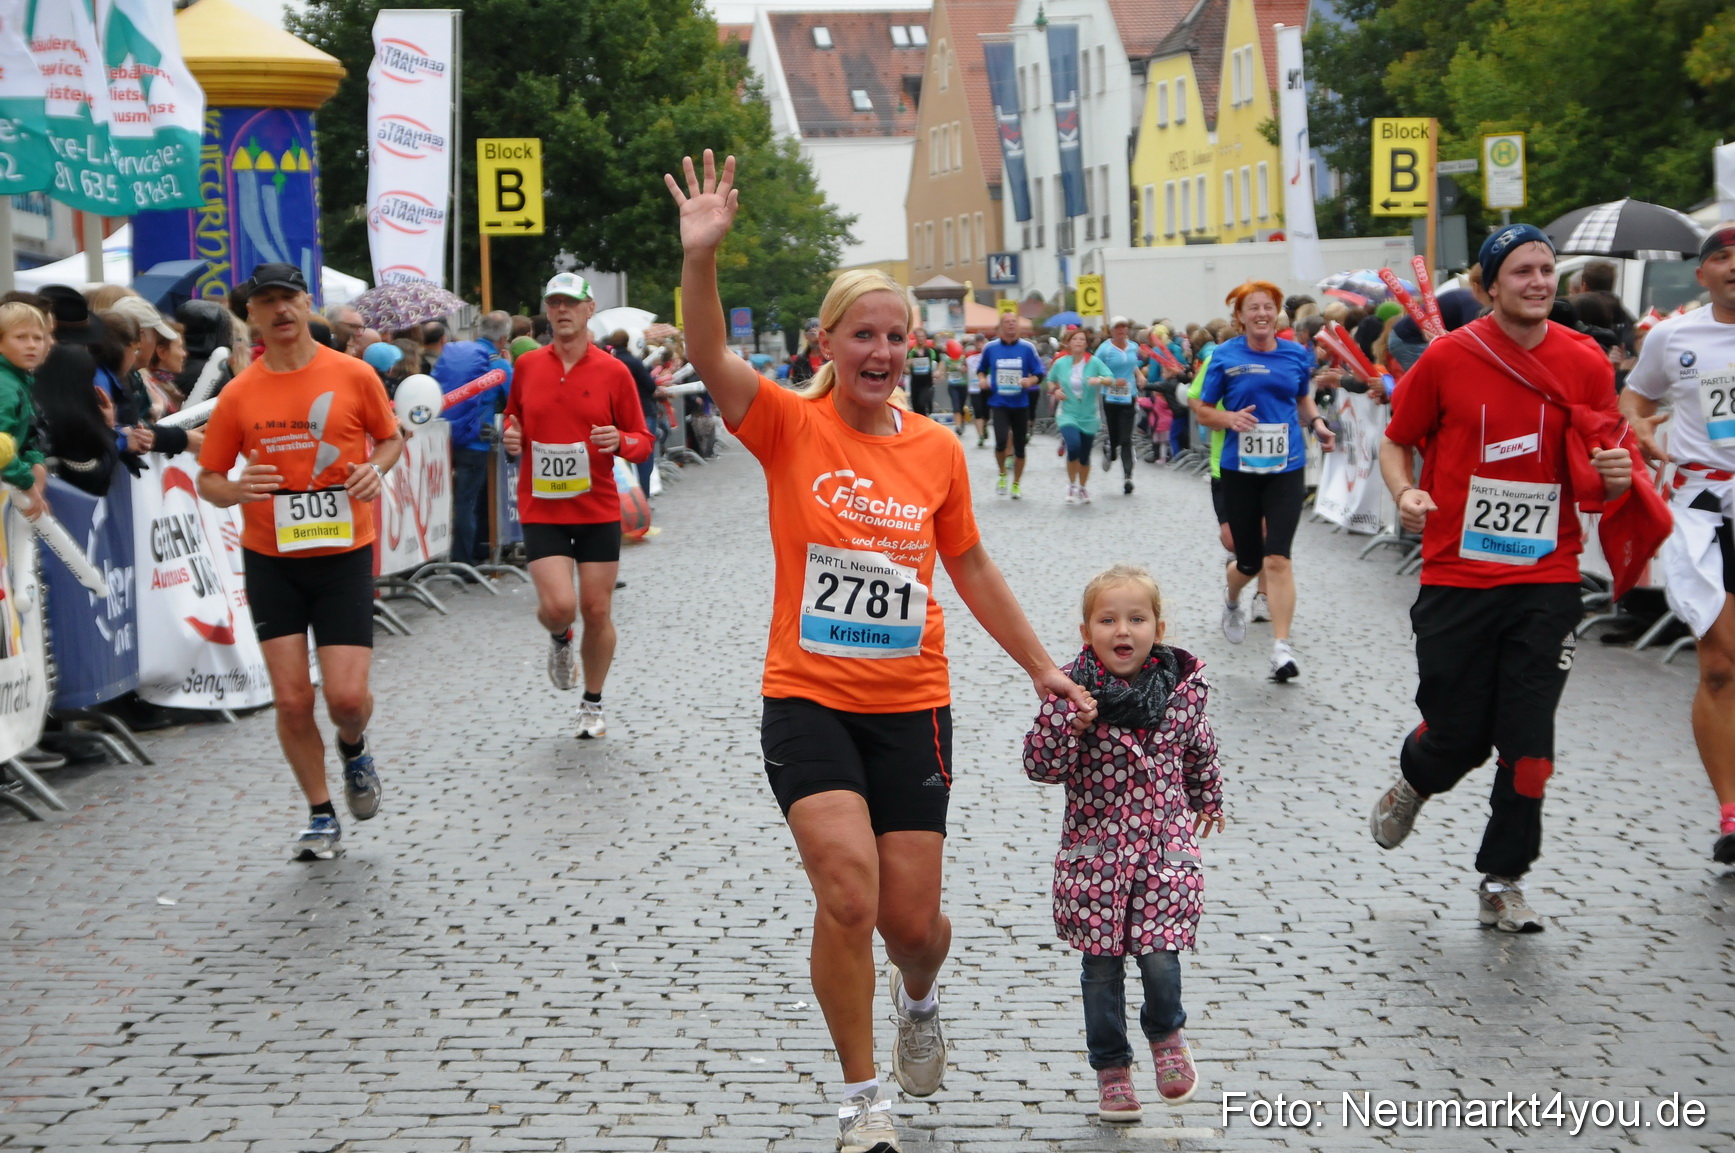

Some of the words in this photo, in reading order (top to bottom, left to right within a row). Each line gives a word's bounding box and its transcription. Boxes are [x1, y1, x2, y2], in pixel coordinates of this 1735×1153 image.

[1381, 122, 1430, 139] Block
[485, 142, 533, 160] Block
[1389, 147, 1420, 193] B
[495, 167, 526, 213] B
[1083, 287, 1099, 308] C
[1701, 376, 1730, 387] PARTL
[266, 420, 286, 429] Mai
[290, 420, 318, 430] 2008
[266, 441, 315, 453] Marathon
[1244, 436, 1285, 454] 3118
[1499, 442, 1524, 455] DEHN
[540, 457, 578, 477] 202
[1471, 484, 1500, 497] PARTL
[1502, 489, 1545, 500] Neumarkt
[289, 490, 338, 521] 503
[831, 485, 929, 520] Fischer
[837, 509, 922, 532] AUTOMOBILE
[1473, 499, 1551, 534] 2327
[293, 525, 340, 539] Bernhard
[851, 536, 876, 548] und
[877, 536, 899, 550] das
[1481, 537, 1536, 555] Christian
[809, 553, 848, 570] PARTL
[814, 571, 912, 620] 2781
[830, 624, 890, 645] Kristina
